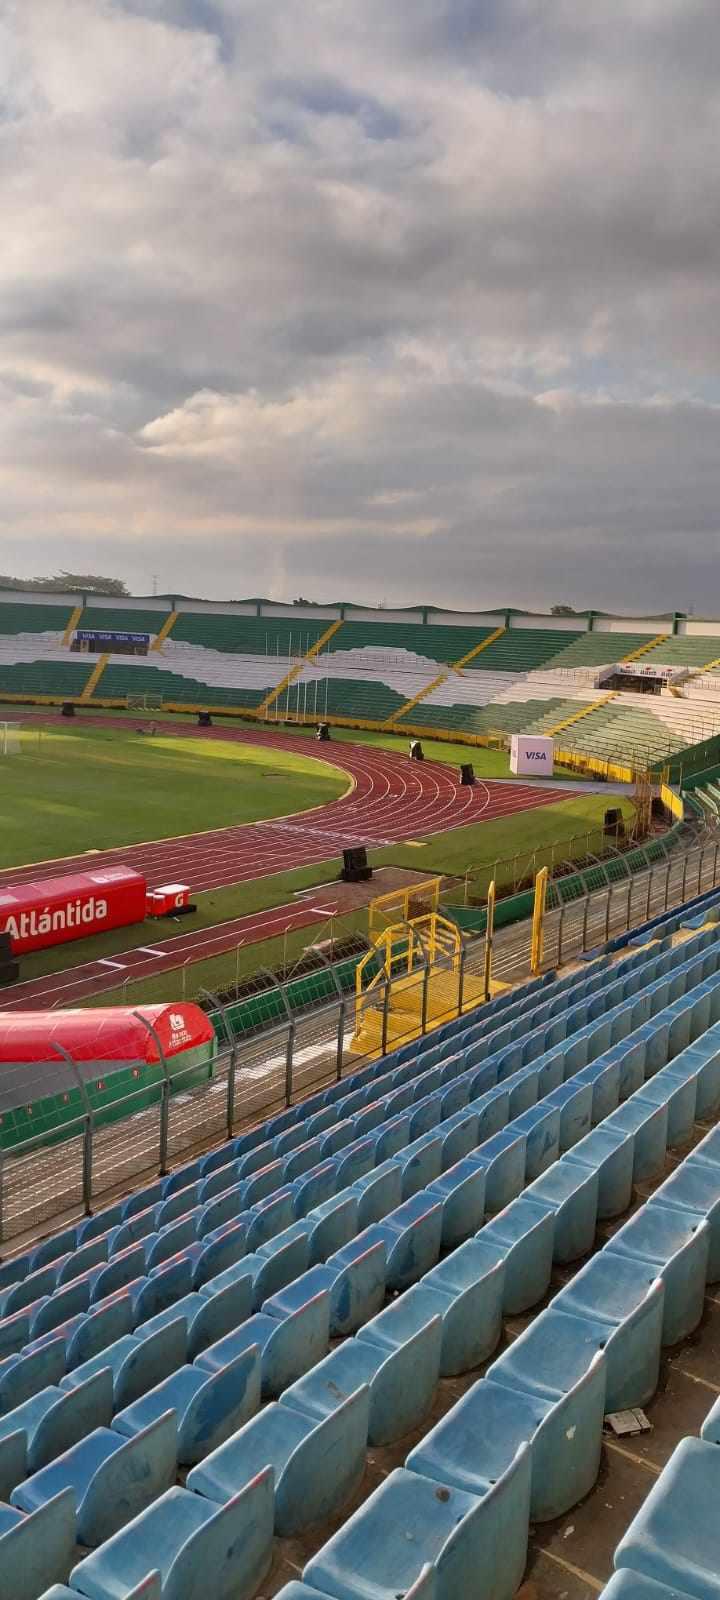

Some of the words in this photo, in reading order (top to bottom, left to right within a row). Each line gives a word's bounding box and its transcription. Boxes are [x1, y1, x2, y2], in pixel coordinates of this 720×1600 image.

[525, 751, 547, 760] VISA
[175, 892, 184, 908] G
[4, 896, 108, 940] Atlántida
